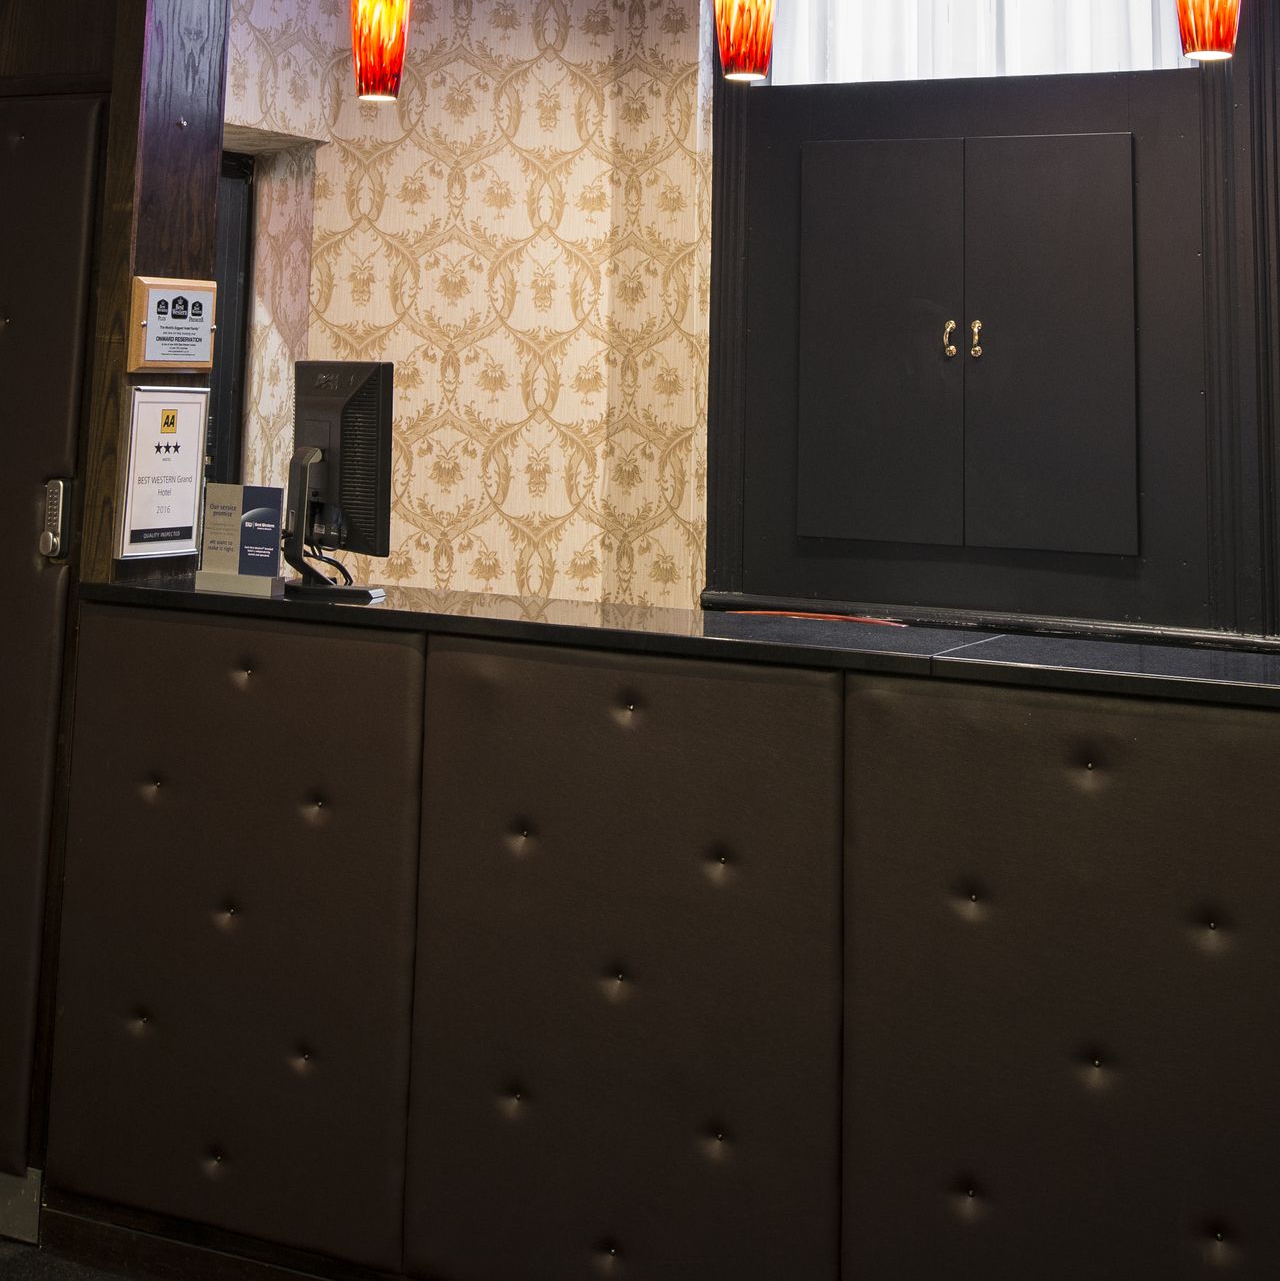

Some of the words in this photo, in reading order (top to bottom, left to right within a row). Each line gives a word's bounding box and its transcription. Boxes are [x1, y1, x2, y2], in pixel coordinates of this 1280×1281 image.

[163, 415, 175, 428] AA
[138, 477, 150, 485] BEST
[152, 476, 176, 484] WESTERN
[177, 476, 193, 484] Grand
[158, 489, 172, 497] Hotel
[157, 506, 171, 514] 2016
